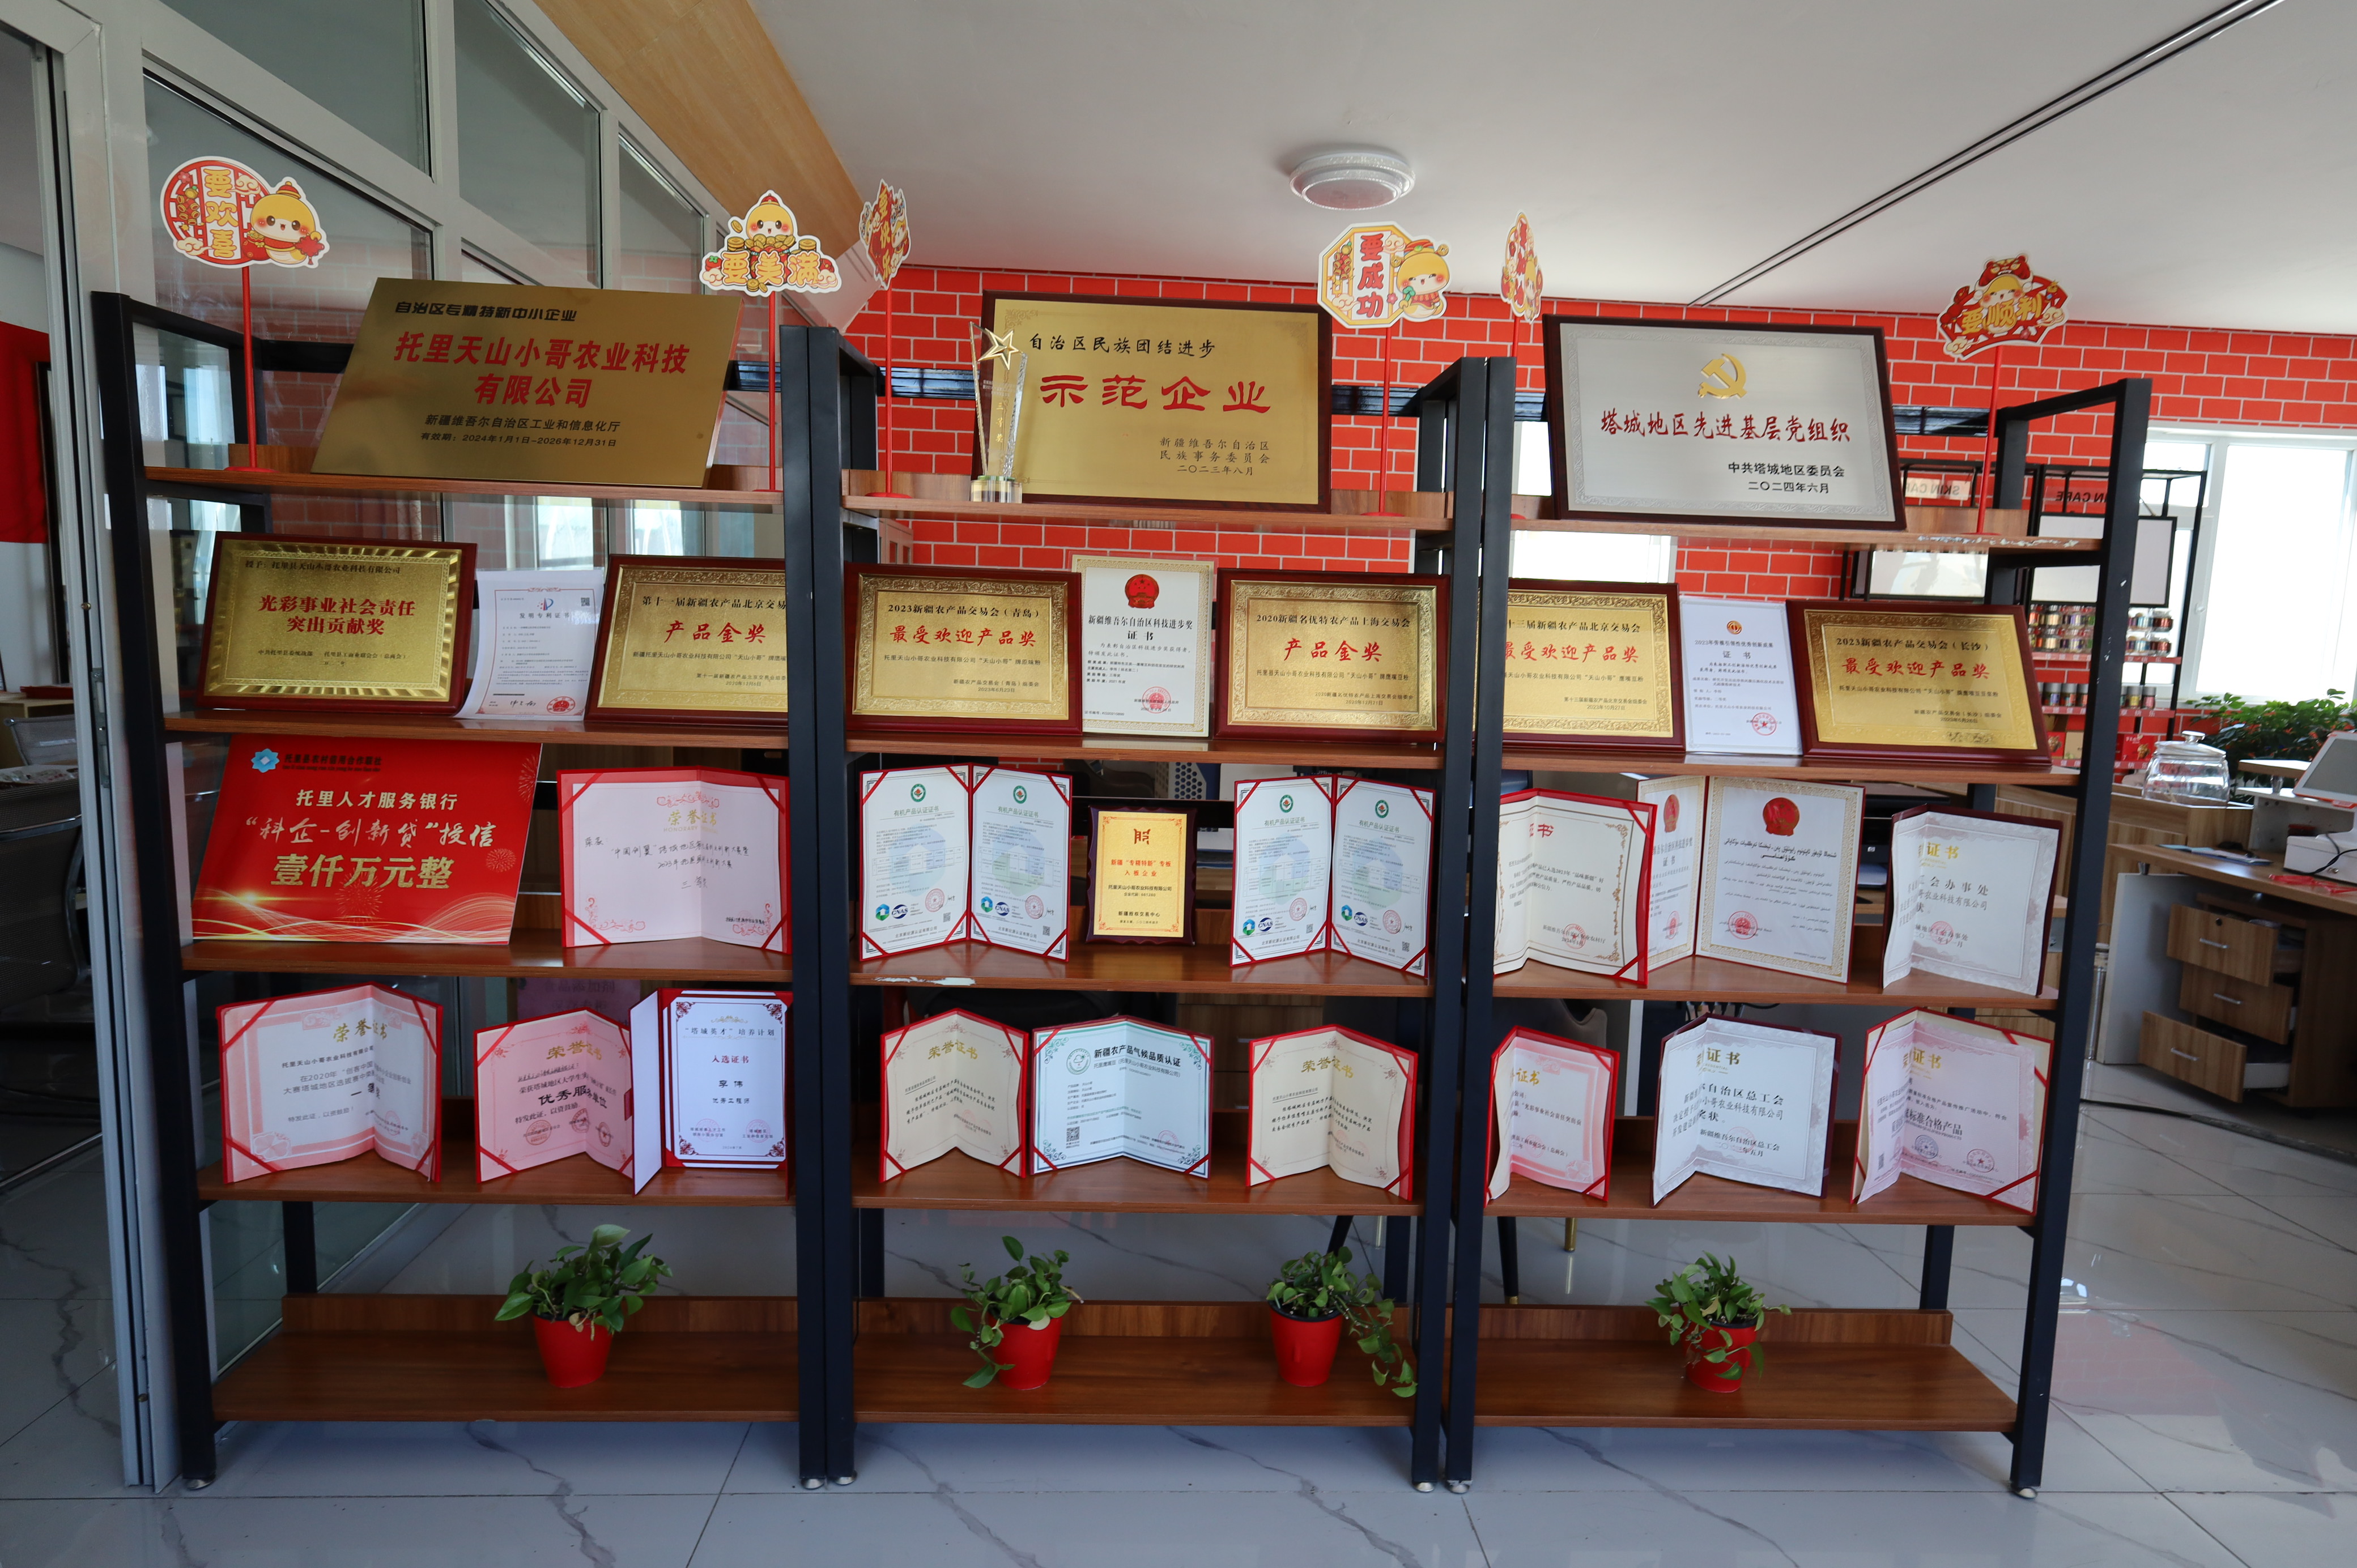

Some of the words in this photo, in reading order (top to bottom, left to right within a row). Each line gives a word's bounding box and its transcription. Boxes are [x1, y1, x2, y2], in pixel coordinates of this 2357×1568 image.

[204, 168, 239, 258] 要欢喜
[722, 252, 821, 286] 要美满
[1357, 233, 1385, 318] 要成功
[395, 301, 577, 322] 自治区专精特新中小企业
[393, 331, 690, 374] 托里天山小哥农业科技
[1029, 333, 1216, 359] 自治区民族团结进步
[474, 373, 593, 408] 有限公司
[1040, 374, 1271, 414] 示范企业
[425, 414, 621, 432] 新疆维吾尔自治区工业和信息化厅
[1601, 407, 1851, 444] 塔城地区先进基层党组织
[1159, 436, 1270, 452] 新疆维吾尔自治区
[1160, 449, 1270, 465] 民族事务委员会
[1728, 462, 1845, 478] 中共塔城地区委员会
[258, 595, 416, 617] 光彩事业社会责任
[287, 616, 385, 636] 突出贡献奖
[1088, 615, 1193, 630] 新疆维吾尔自治区科技进步奖
[1256, 613, 1411, 628] 2020新疆名优特农产品上海交易会
[663, 620, 767, 644] 产品金奖
[890, 624, 1037, 647] 最受欢迎产品奖
[1127, 630, 1154, 641] 证书
[1284, 637, 1382, 662] 产品金奖
[1722, 650, 1751, 659] 证书
[1841, 657, 1991, 680] 最受欢迎产品奖
[295, 789, 458, 811] 托里人才服务银行
[893, 806, 939, 817] 有机产品认证证书
[997, 806, 1039, 819] 有机产品认证证书
[1264, 816, 1305, 827] 有机产品认证证书
[1359, 819, 1400, 834] 有机产品认证证书
[270, 853, 454, 889] 壹仟万元整
[891, 906, 909, 915] CNAS
[1354, 915, 1368, 923] CNAS
[712, 1055, 750, 1064] 入选证书
[928, 1039, 978, 1060] 荣誉证书
[1094, 1045, 1181, 1067] 新疆农产品气候品质认证
